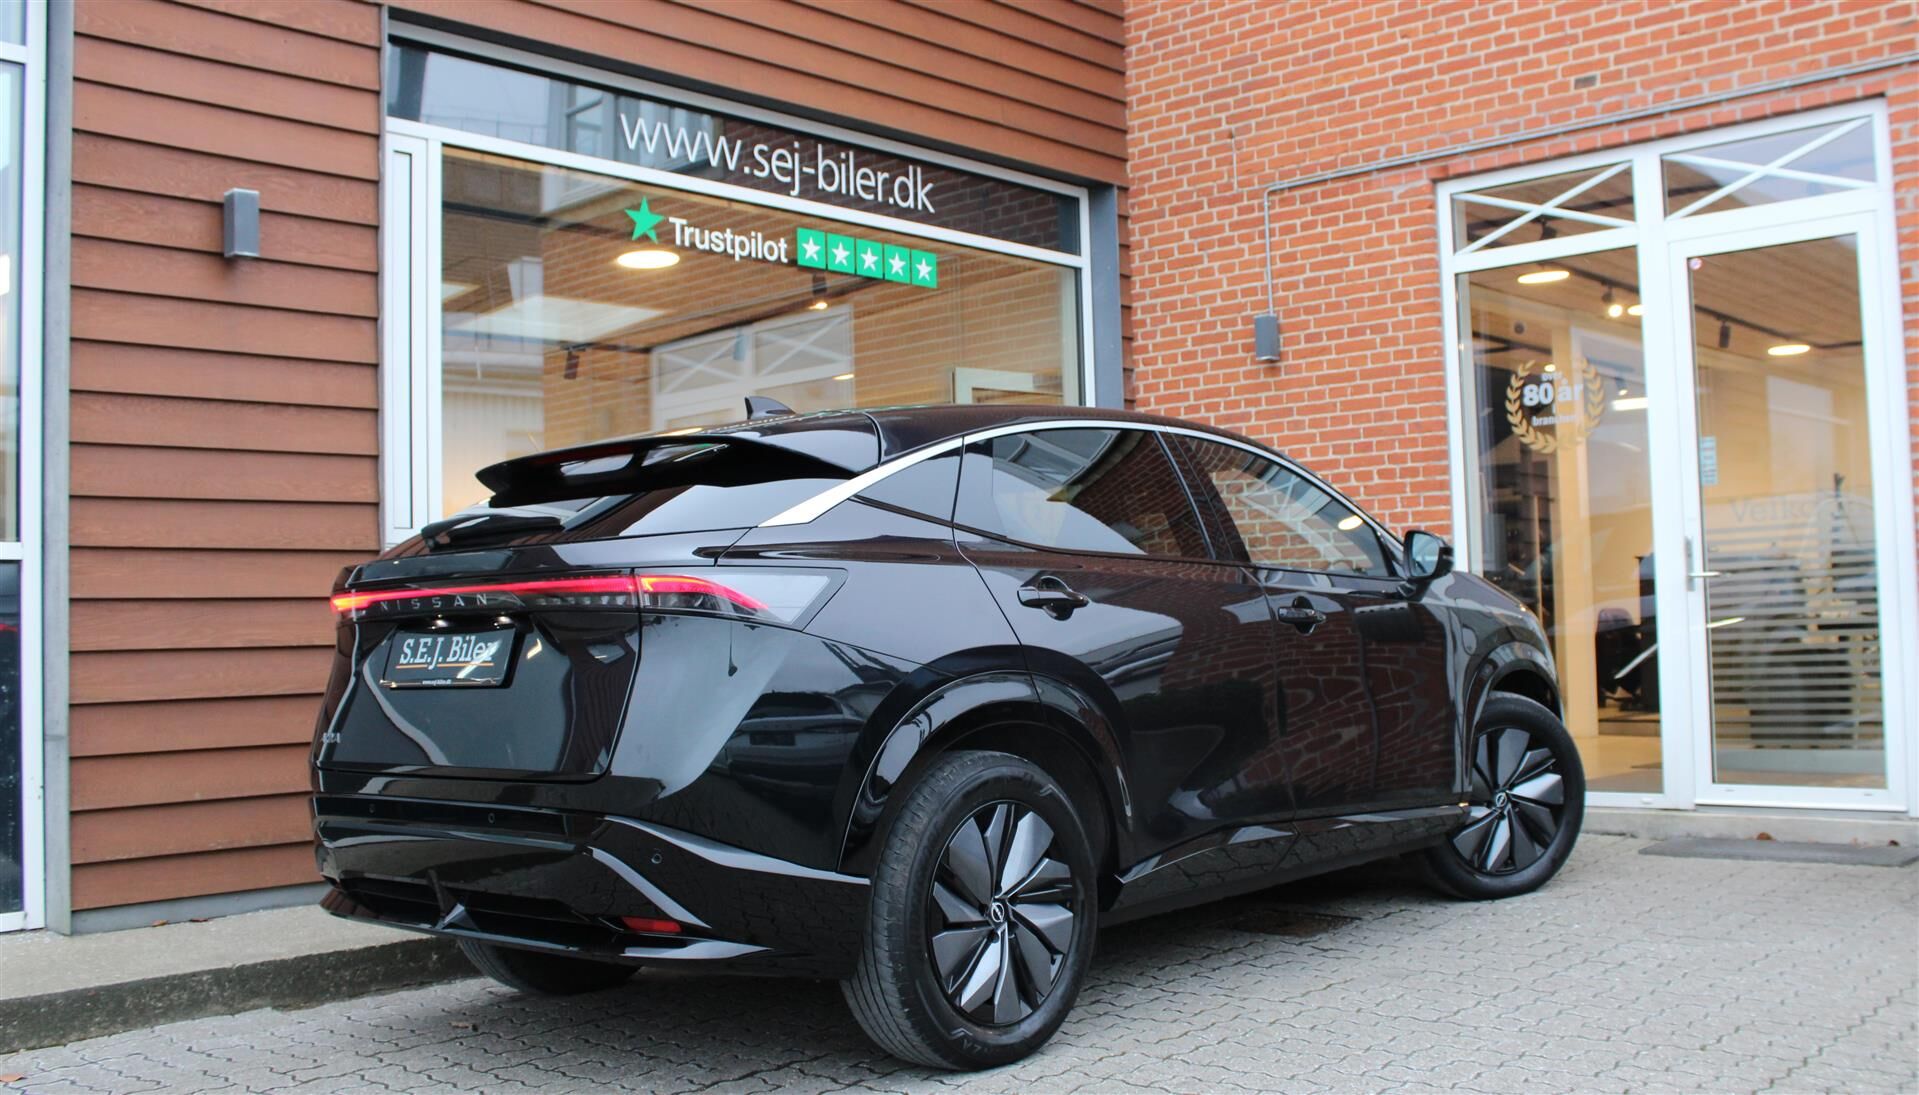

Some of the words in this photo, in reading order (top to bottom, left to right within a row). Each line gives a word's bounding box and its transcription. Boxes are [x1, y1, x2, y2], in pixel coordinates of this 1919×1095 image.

[620, 113, 936, 214] www.sej-biler.dk
[669, 216, 788, 264] Trustpilot
[1523, 383, 1554, 407] 80
[379, 593, 488, 612] NISSAN
[399, 637, 445, 670] S.E.J.
[446, 636, 496, 663] Biler
